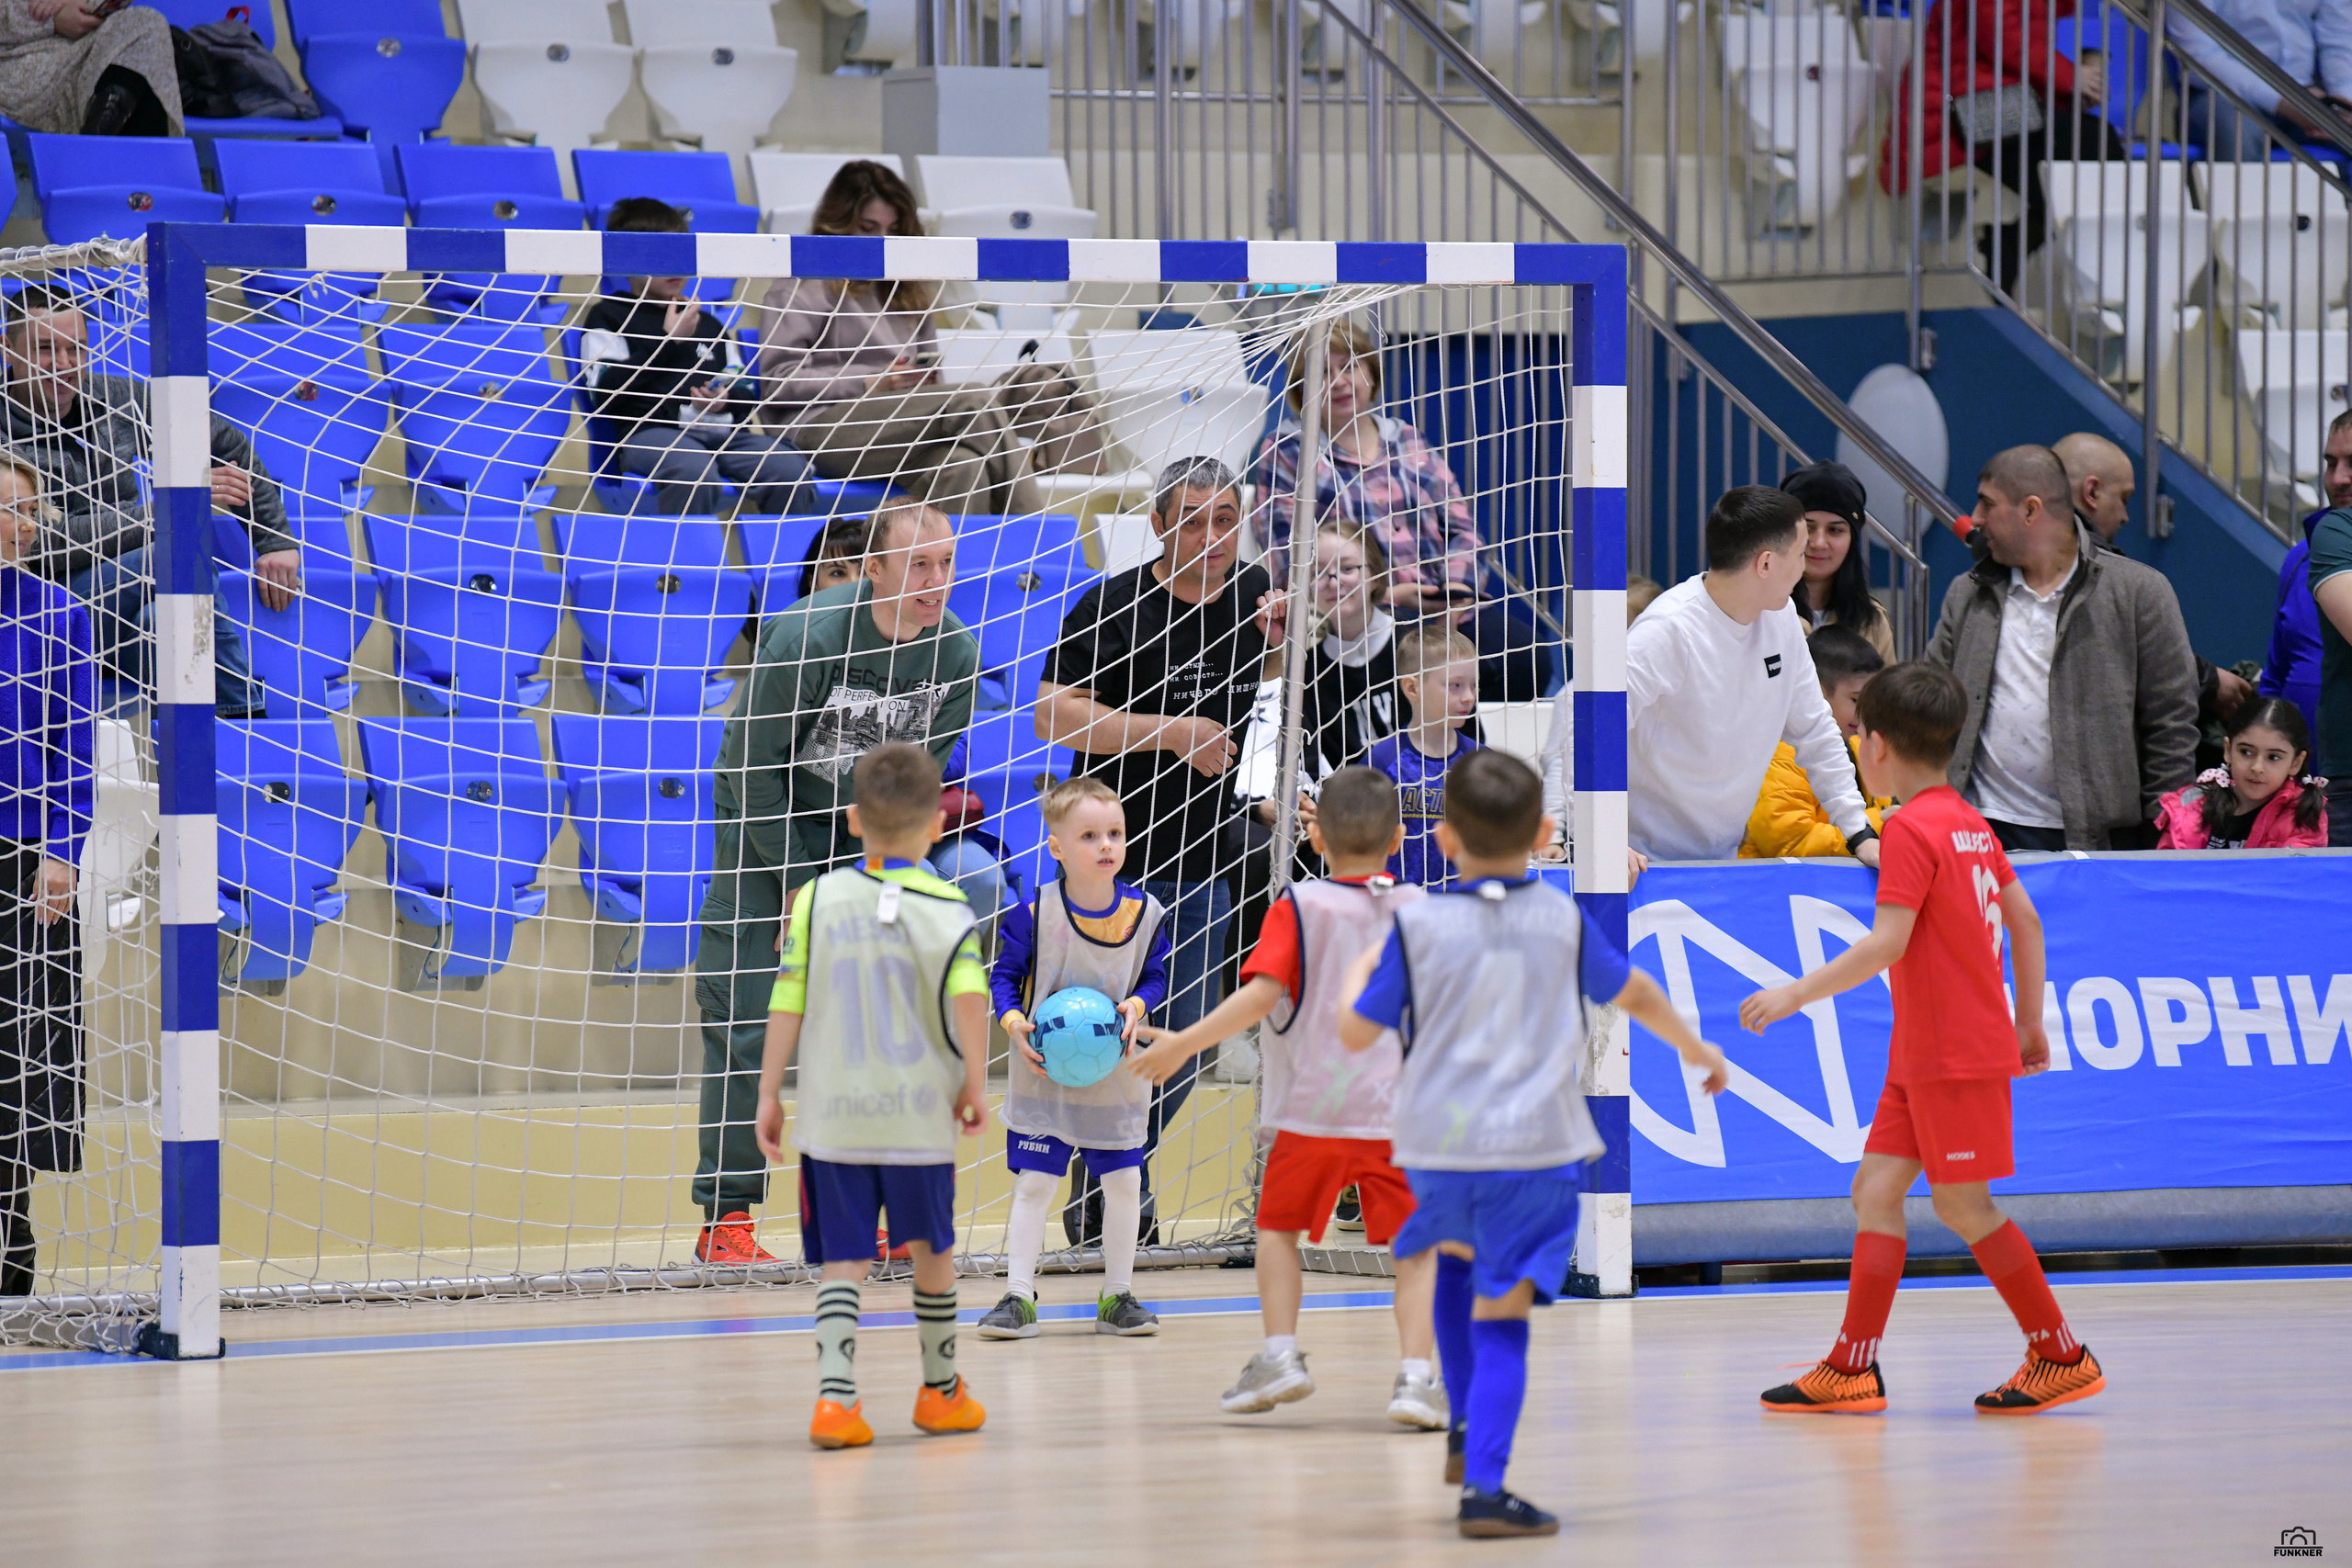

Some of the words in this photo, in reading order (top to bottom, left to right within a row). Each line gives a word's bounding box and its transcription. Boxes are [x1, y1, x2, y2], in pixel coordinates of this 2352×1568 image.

[831, 687, 842, 697] OT
[844, 689, 906, 711] PERFEON
[831, 954, 926, 1072] 10
[1017, 1140, 1050, 1154] РУБИН
